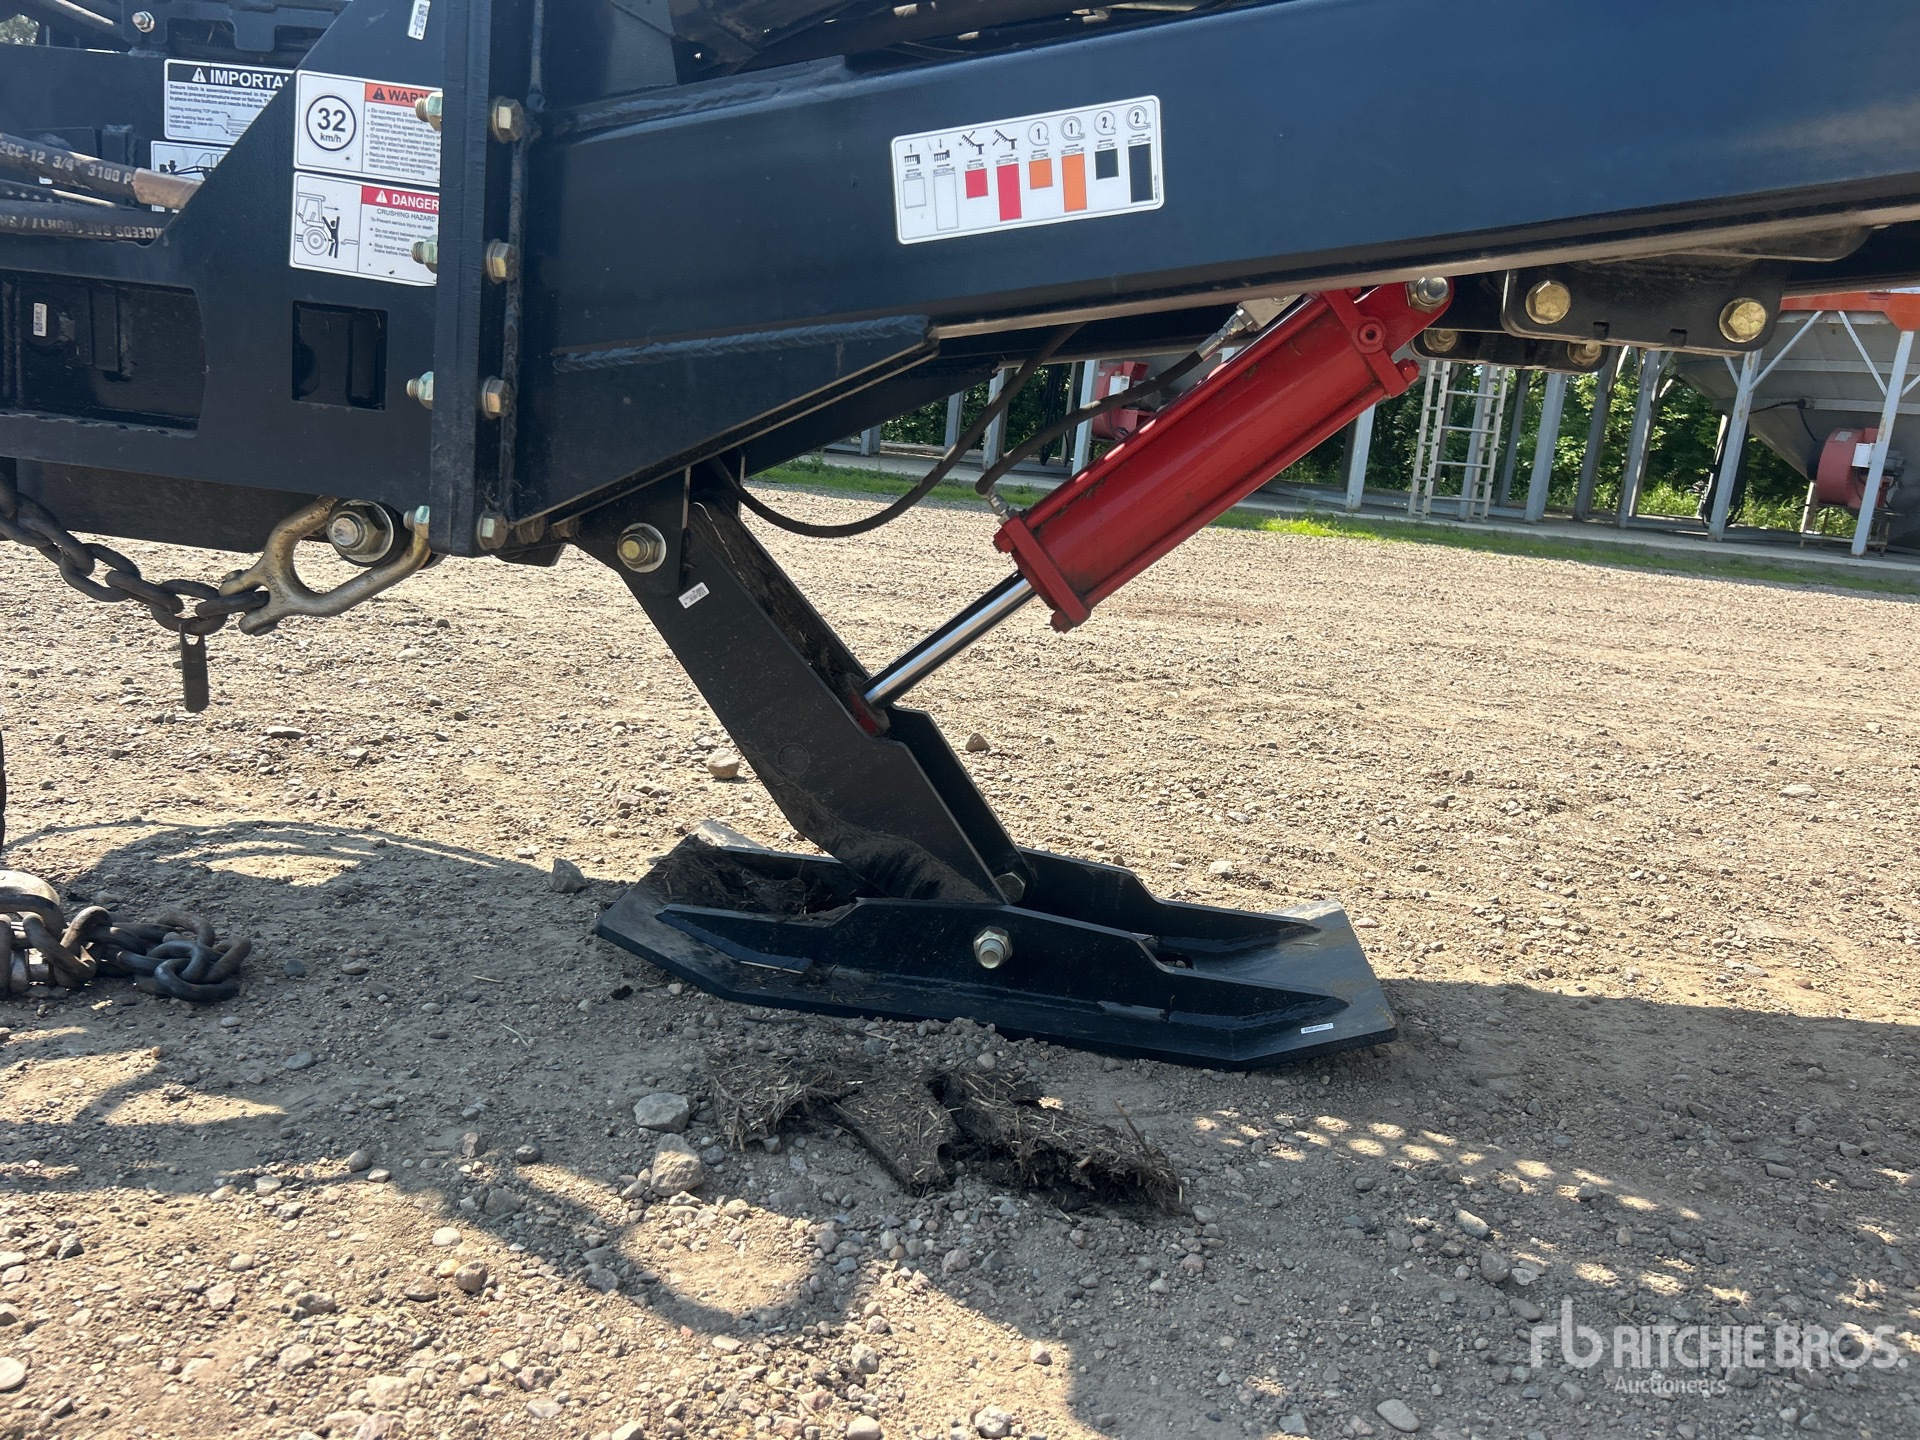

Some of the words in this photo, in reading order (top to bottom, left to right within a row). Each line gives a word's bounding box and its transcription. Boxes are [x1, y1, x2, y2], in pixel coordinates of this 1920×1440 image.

[210, 69, 289, 89] IMPORTA
[318, 107, 346, 132] 32
[1102, 117, 1107, 128] 2
[1134, 112, 1140, 124] 2
[1037, 128, 1041, 140] 1
[1069, 123, 1073, 134] 1
[320, 132, 341, 143] km/h
[88, 164, 120, 183] 3100
[392, 194, 439, 211] DANGER
[377, 208, 410, 218] CRUSHING
[411, 214, 436, 222] HAZARD
